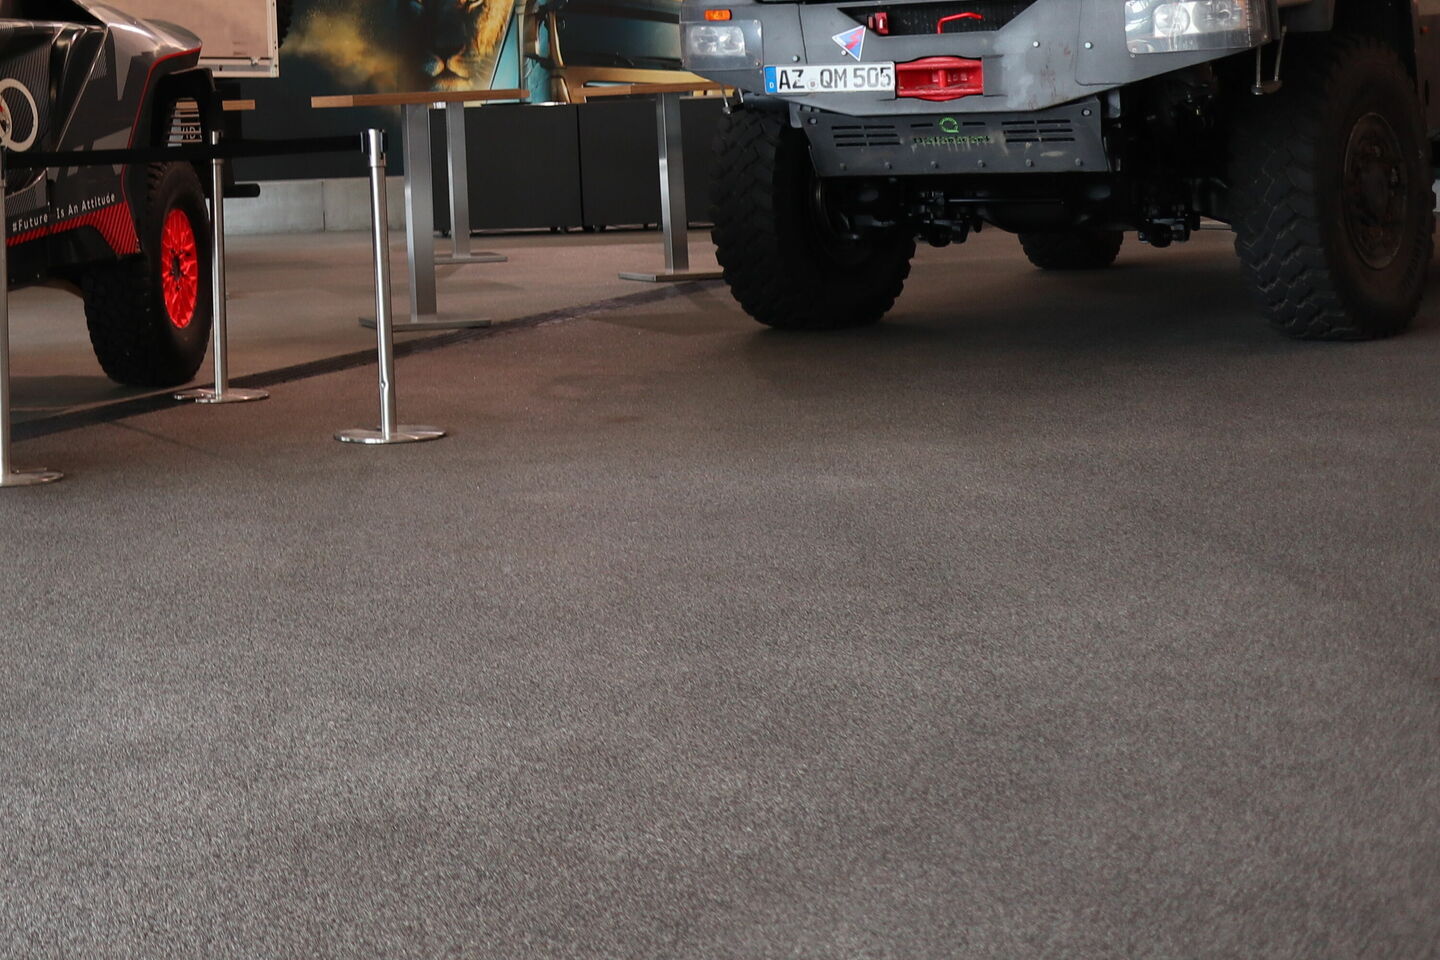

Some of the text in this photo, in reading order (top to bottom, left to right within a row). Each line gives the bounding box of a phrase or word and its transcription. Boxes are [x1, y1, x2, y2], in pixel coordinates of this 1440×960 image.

[779, 69, 805, 90] AZ
[820, 67, 848, 89] QM
[853, 65, 892, 88] 505
[12, 192, 116, 232] #Future Is An Attitude
